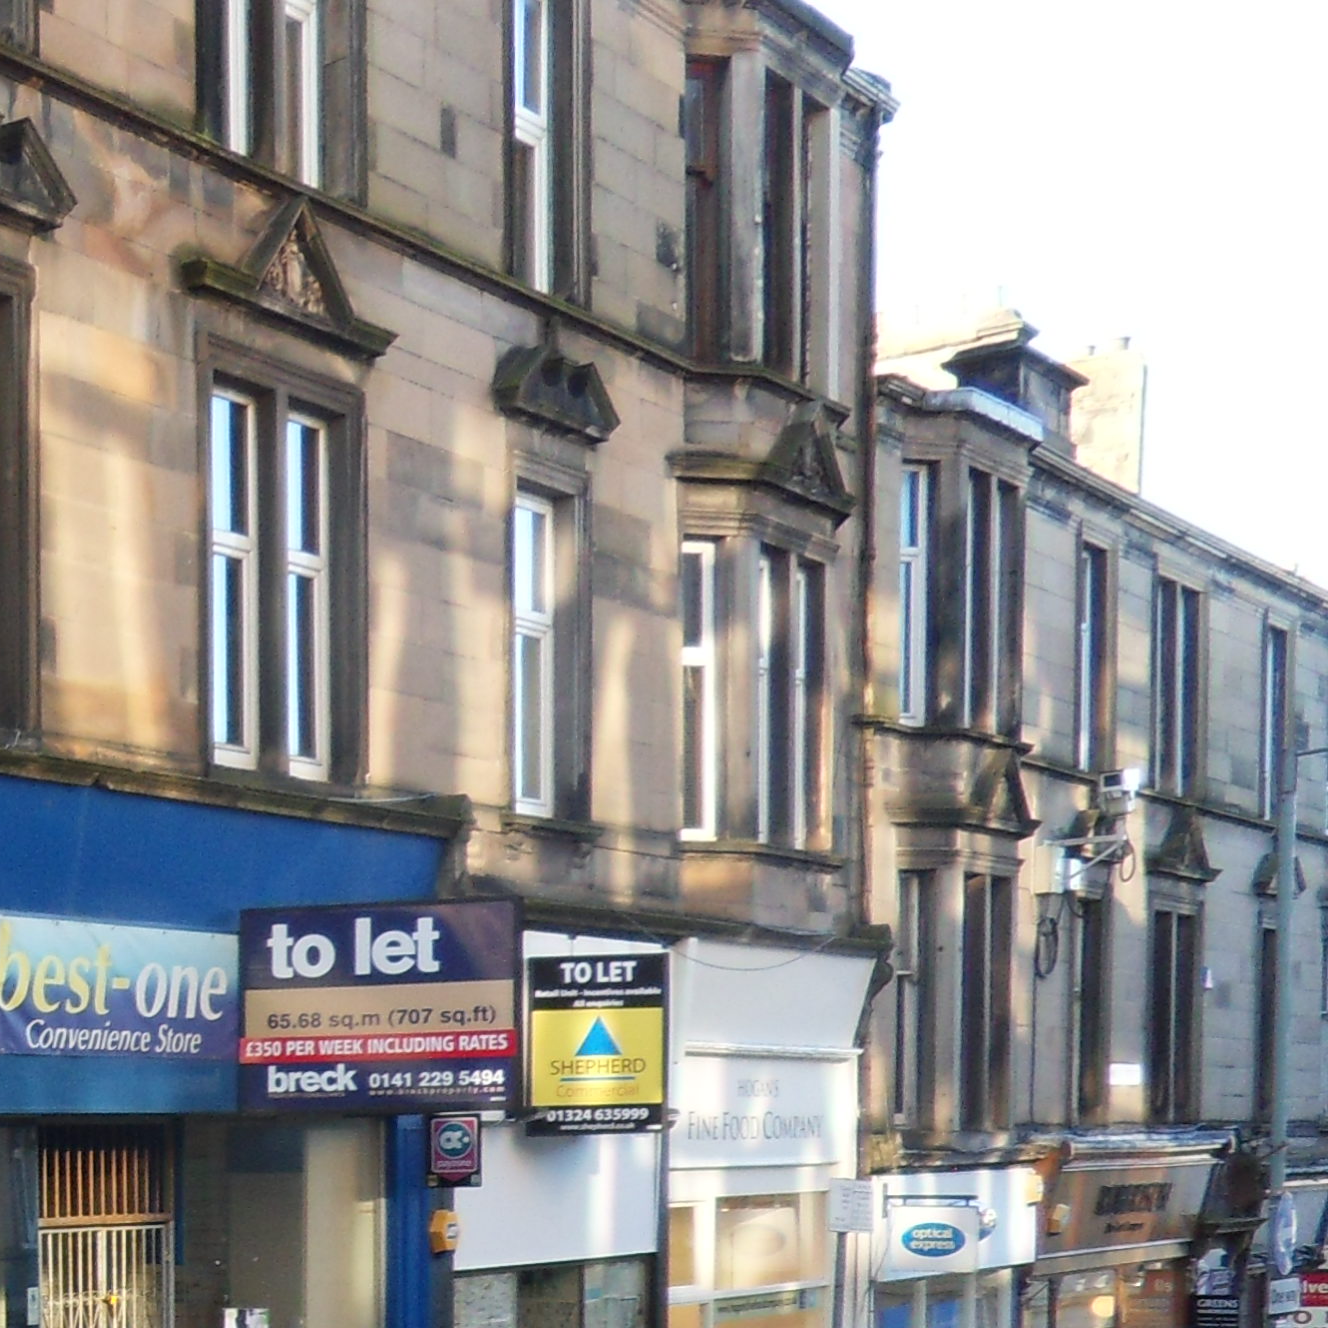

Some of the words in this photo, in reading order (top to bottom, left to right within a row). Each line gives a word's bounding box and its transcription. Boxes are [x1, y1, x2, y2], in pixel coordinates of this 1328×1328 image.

[267, 923, 336, 979] to
[354, 916, 440, 975] let
[560, 962, 592, 984] TO
[597, 960, 637, 982] LET
[267, 1013, 322, 1030] 65.68
[329, 1013, 381, 1030] sq.m
[388, 1008, 433, 1027] (707
[440, 1005, 497, 1026] sq.ft)
[25, 1018, 151, 1051] Convenience
[155, 1023, 203, 1053] Store
[246, 1041, 281, 1058] £350
[286, 1040, 315, 1057] PER
[318, 1037, 362, 1055] WEEK
[368, 1034, 454, 1053] INCLUDING
[459, 1033, 509, 1051] RATES
[267, 1063, 357, 1093] breck
[369, 1072, 412, 1088] 0141
[419, 1070, 454, 1087] 229
[458, 1068, 506, 1086] 5494
[550, 1058, 646, 1076] SHEPHERD
[555, 1083, 640, 1099] Commercial
[547, 1109, 592, 1122] 01324
[594, 1107, 649, 1121] 635999
[912, 1227, 953, 1239] optical
